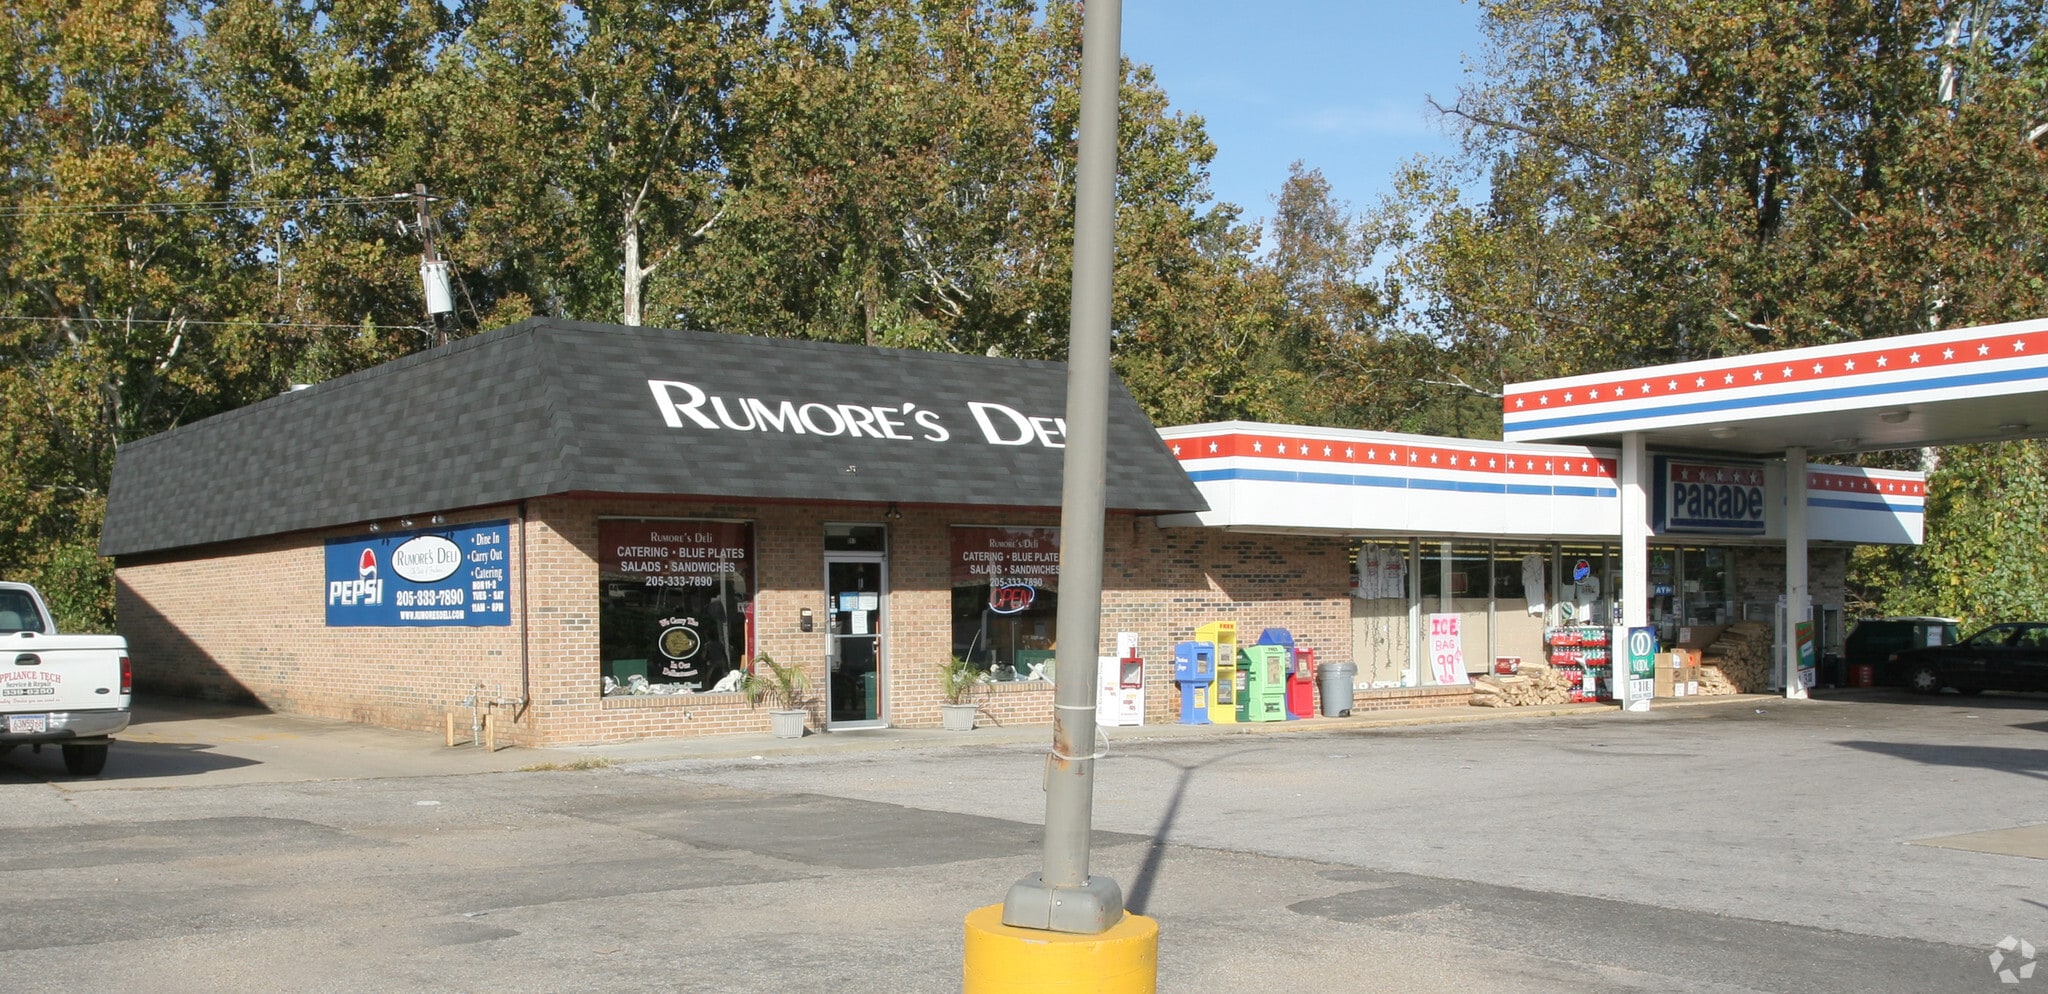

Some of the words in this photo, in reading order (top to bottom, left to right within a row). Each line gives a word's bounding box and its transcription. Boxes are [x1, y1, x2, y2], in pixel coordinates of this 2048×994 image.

[476, 532, 490, 545] Dine
[492, 532, 500, 544] In
[471, 550, 488, 565] Carry
[489, 548, 503, 561] Out
[617, 546, 668, 558] CATERING
[679, 547, 705, 558] BLUE
[708, 548, 745, 559] PLATES
[963, 551, 1004, 562] CATERING
[1012, 552, 1033, 562] BLUE
[1034, 552, 1059, 562] PLATE
[621, 561, 661, 572] SALADS
[671, 562, 736, 573] SANDWICHES
[970, 564, 1002, 575] SALADS
[1009, 565, 1060, 575] SANDWICHES
[474, 566, 503, 582] Catering
[645, 576, 712, 587] 205-333-7890
[990, 577, 1043, 587] 205-333-7890
[329, 578, 383, 605] PEPSI
[396, 588, 464, 606] 205-333-7890
[472, 590, 487, 601] TUES
[493, 590, 504, 600] SAT
[991, 588, 1032, 608] OPEN
[1432, 618, 1458, 636] ICE
[1435, 639, 1456, 652] BAG
[0, 671, 37, 683] PPLIANCE
[40, 672, 61, 683] TECH
